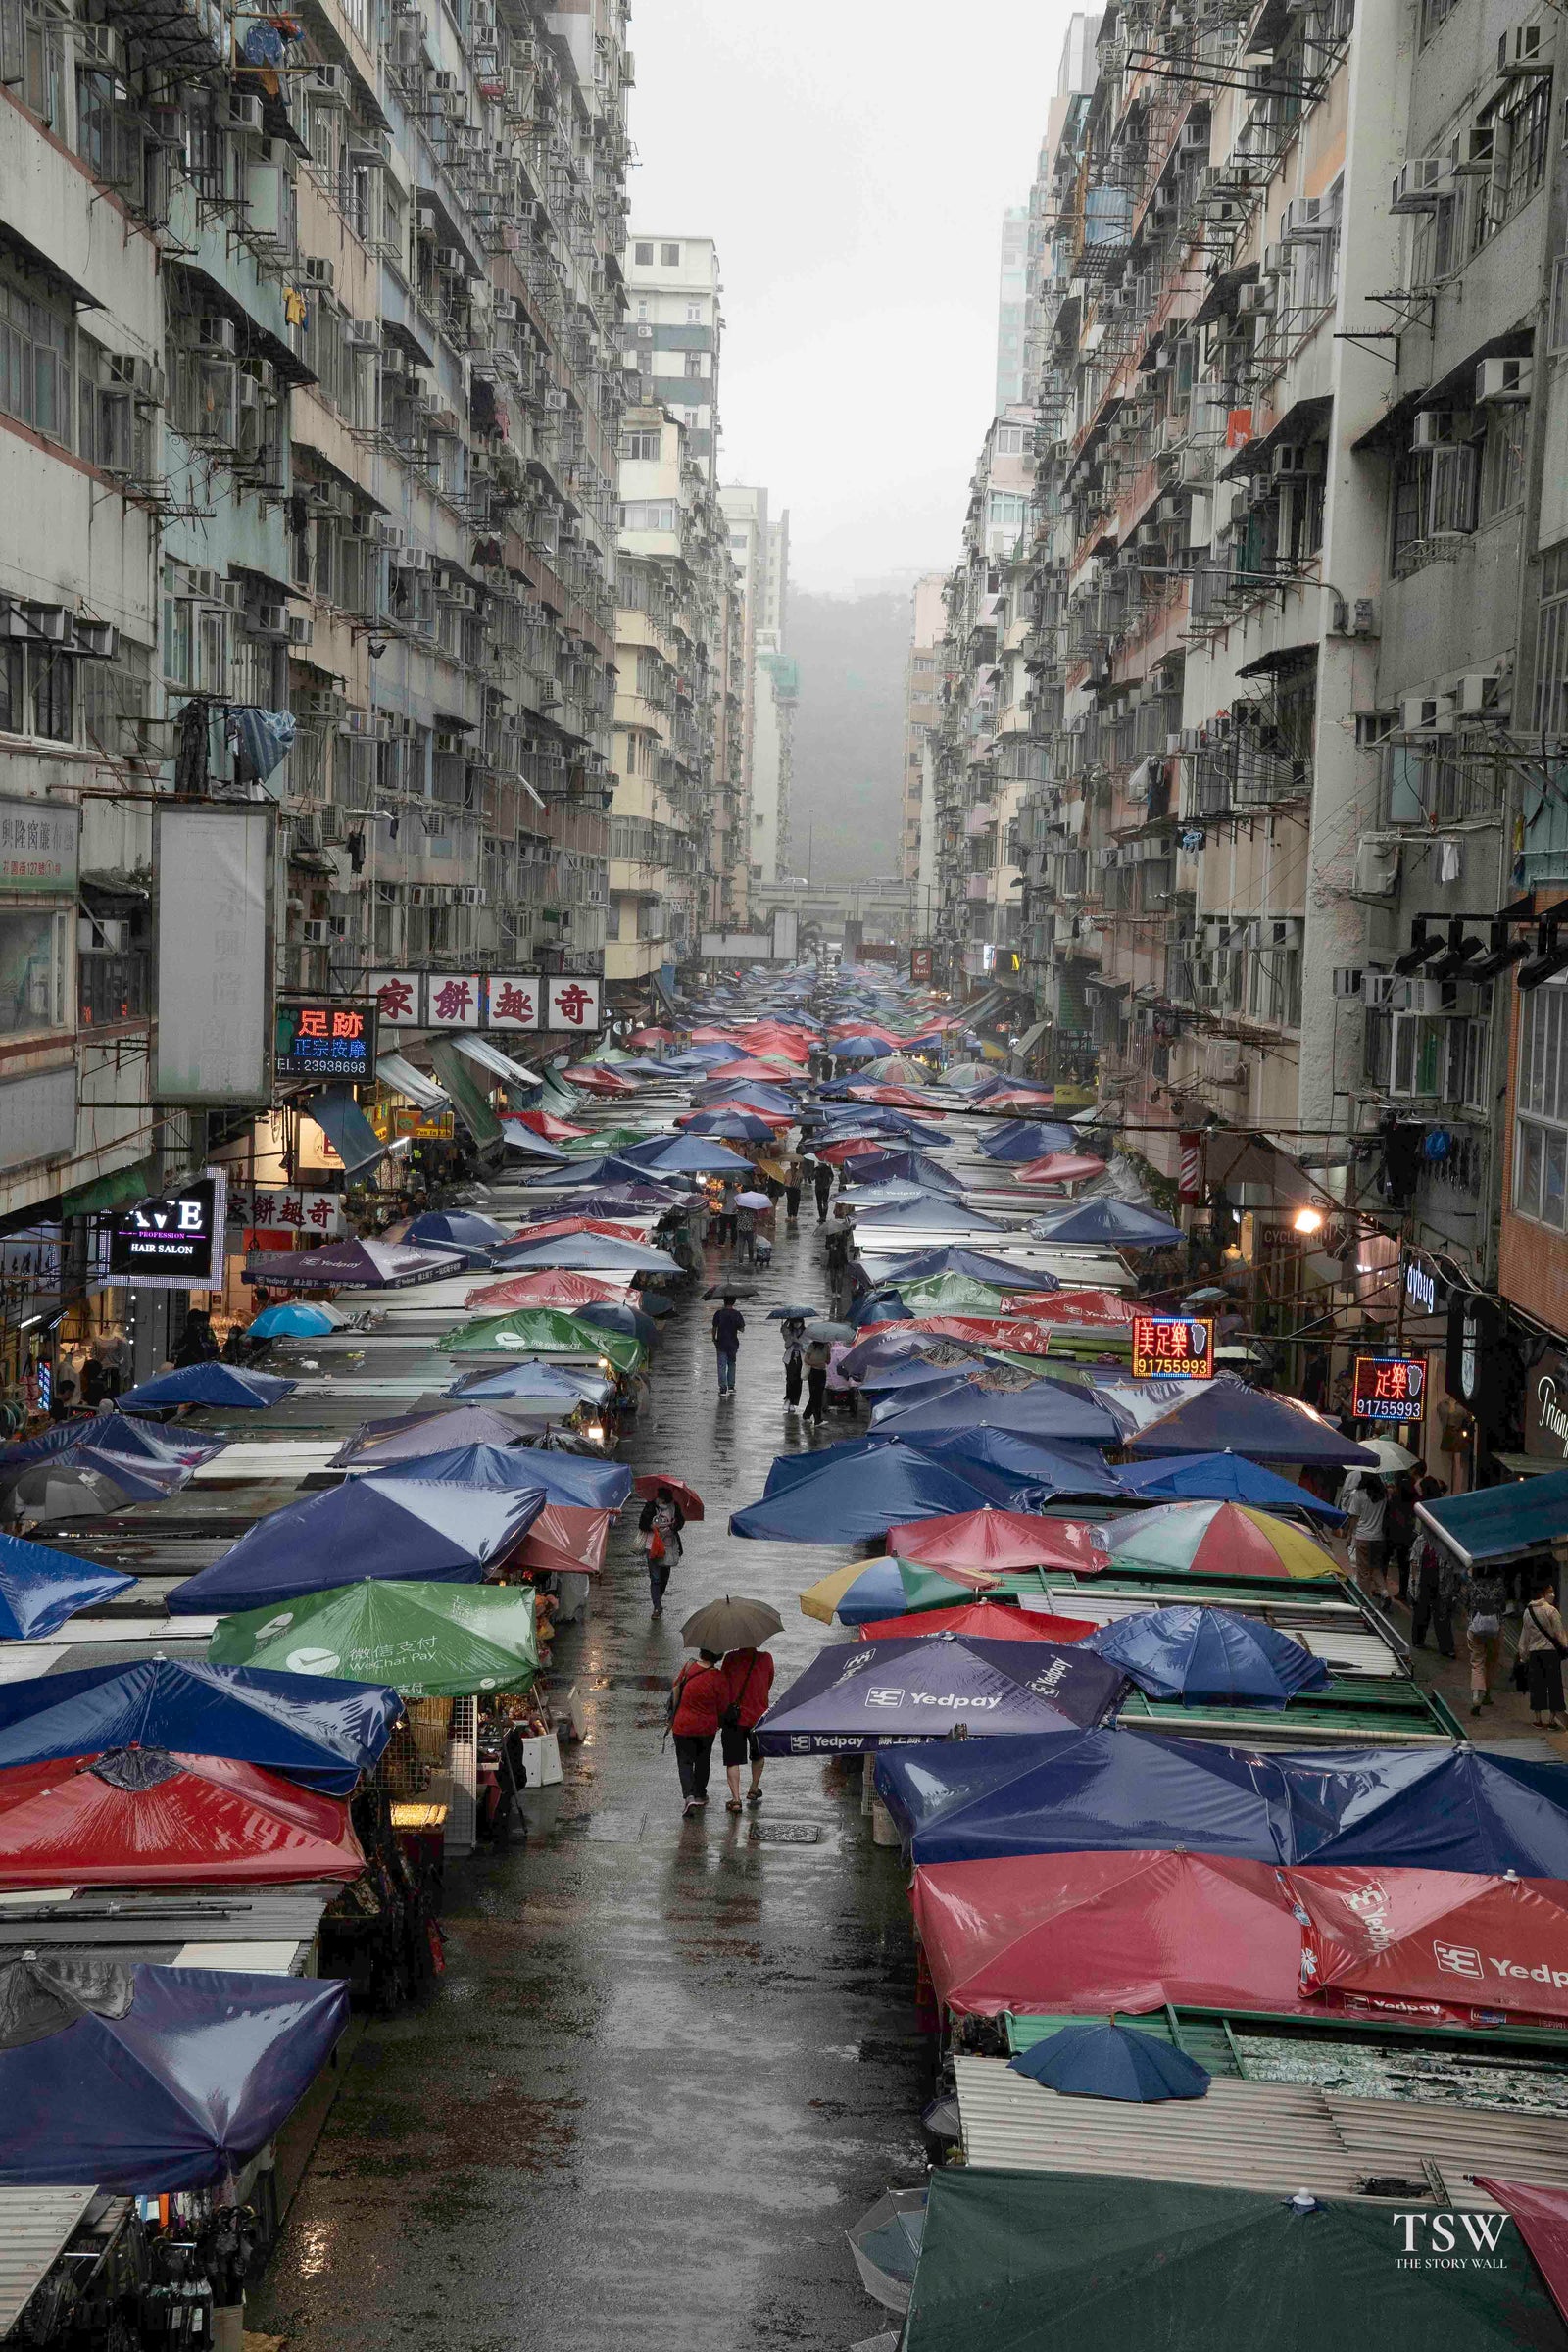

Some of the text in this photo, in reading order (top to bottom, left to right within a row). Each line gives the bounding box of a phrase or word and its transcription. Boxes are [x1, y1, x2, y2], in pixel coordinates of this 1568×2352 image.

[298, 1010, 364, 1039] 足跡
[293, 1038, 368, 1059] 正宗按摩
[304, 1059, 366, 1074] 23938698
[1264, 1230, 1300, 1244] CYCLE
[130, 1243, 194, 1255] HAIR SALON
[320, 1259, 364, 1270] Yedpay
[265, 1276, 288, 1286] Yedpay
[543, 1295, 592, 1305] Yedpay
[1139, 1320, 1188, 1358] 美足樂
[1138, 1358, 1207, 1374] 91755993
[1357, 1399, 1421, 1417] 91755993
[349, 1635, 438, 1661] 微信支付
[1036, 1657, 1073, 1687] Yedpay
[910, 1691, 1002, 1710] Yedpay
[813, 1735, 864, 1749] Yedpay
[1373, 1999, 1441, 2015] Yedpay
